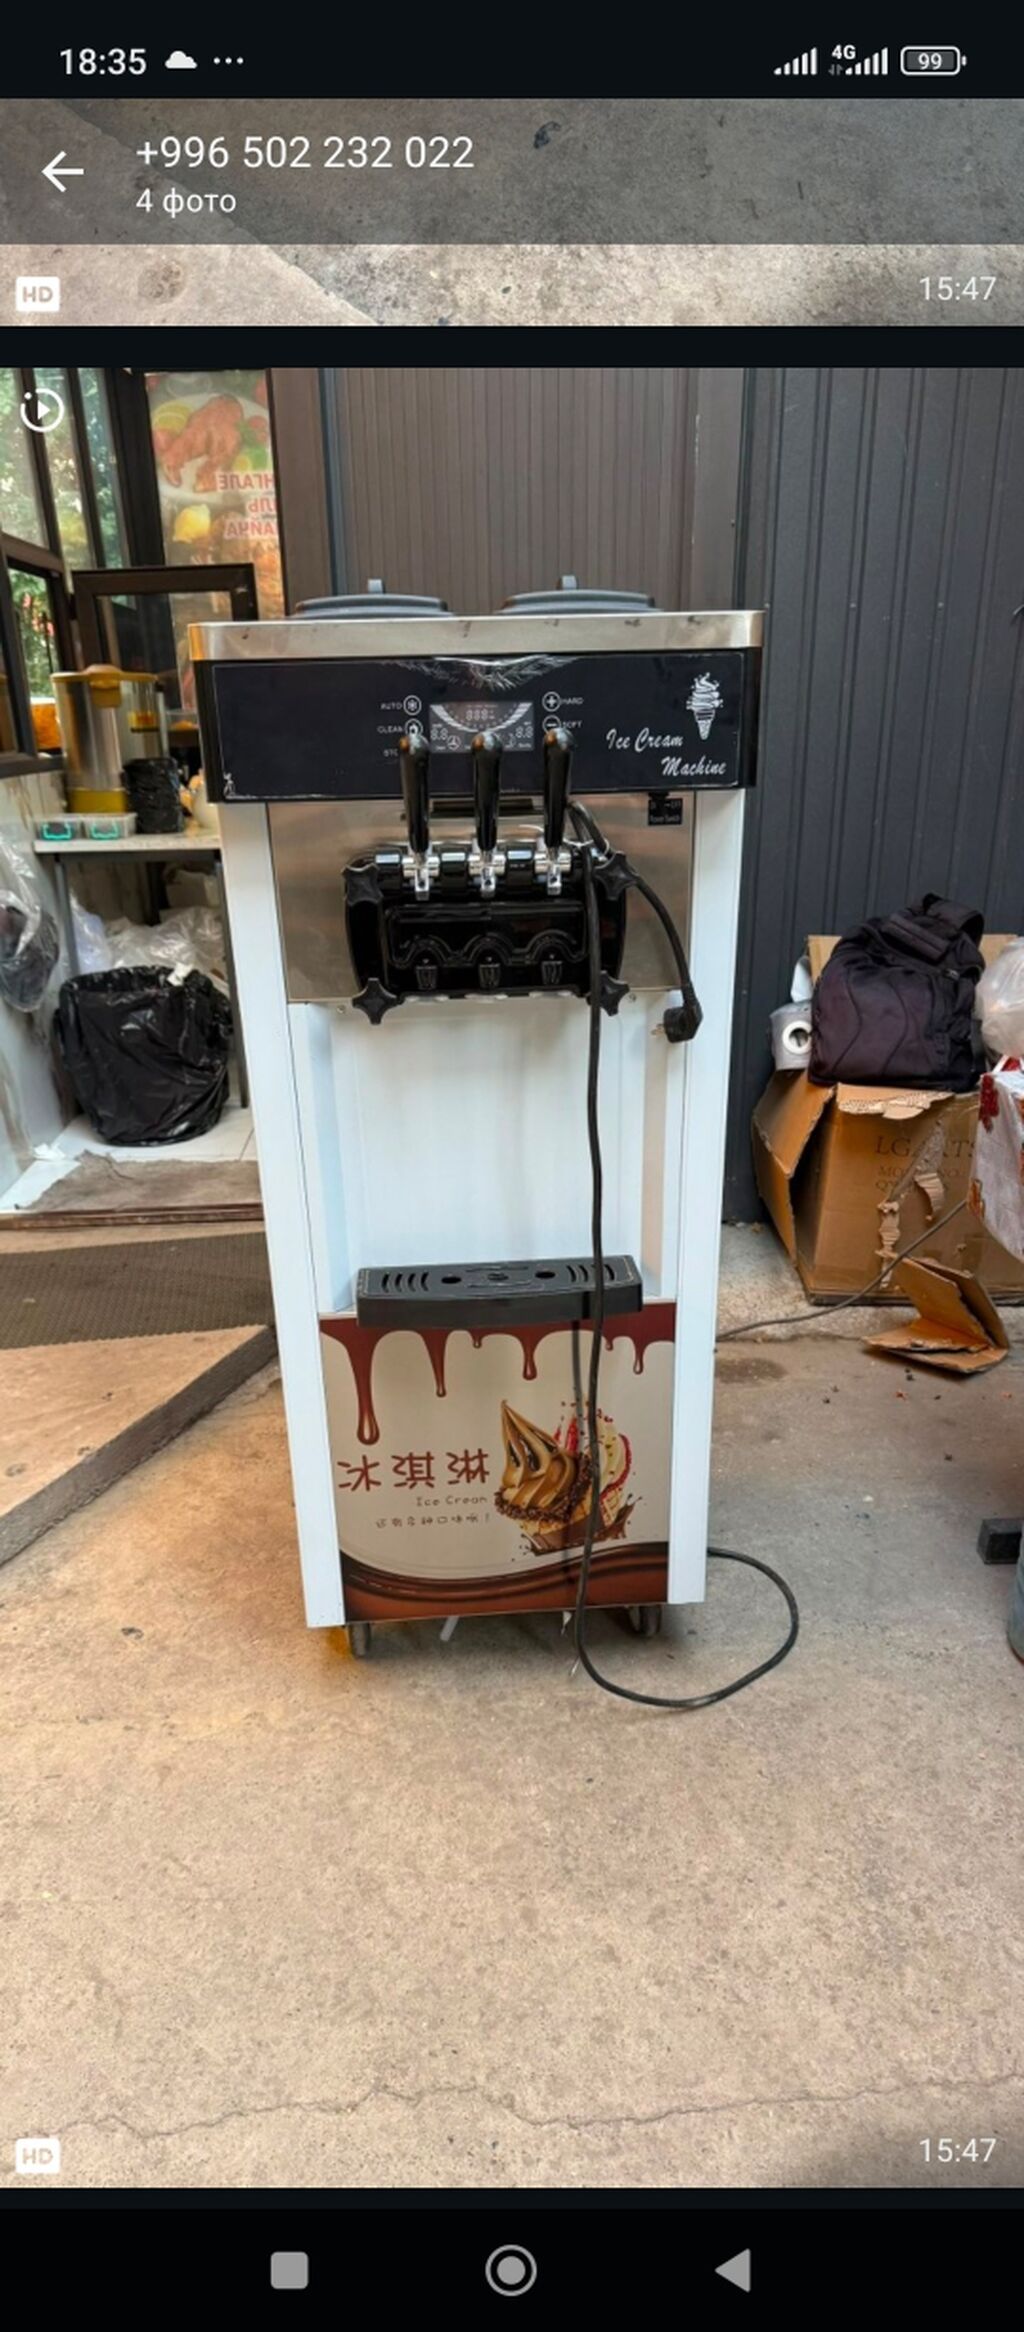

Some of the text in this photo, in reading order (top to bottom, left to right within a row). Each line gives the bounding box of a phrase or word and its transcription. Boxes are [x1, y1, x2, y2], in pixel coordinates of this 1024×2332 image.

[605, 726, 684, 753] Ice Cream
[661, 754, 728, 777] Machine
[336, 1448, 490, 1492] 冰淇淋
